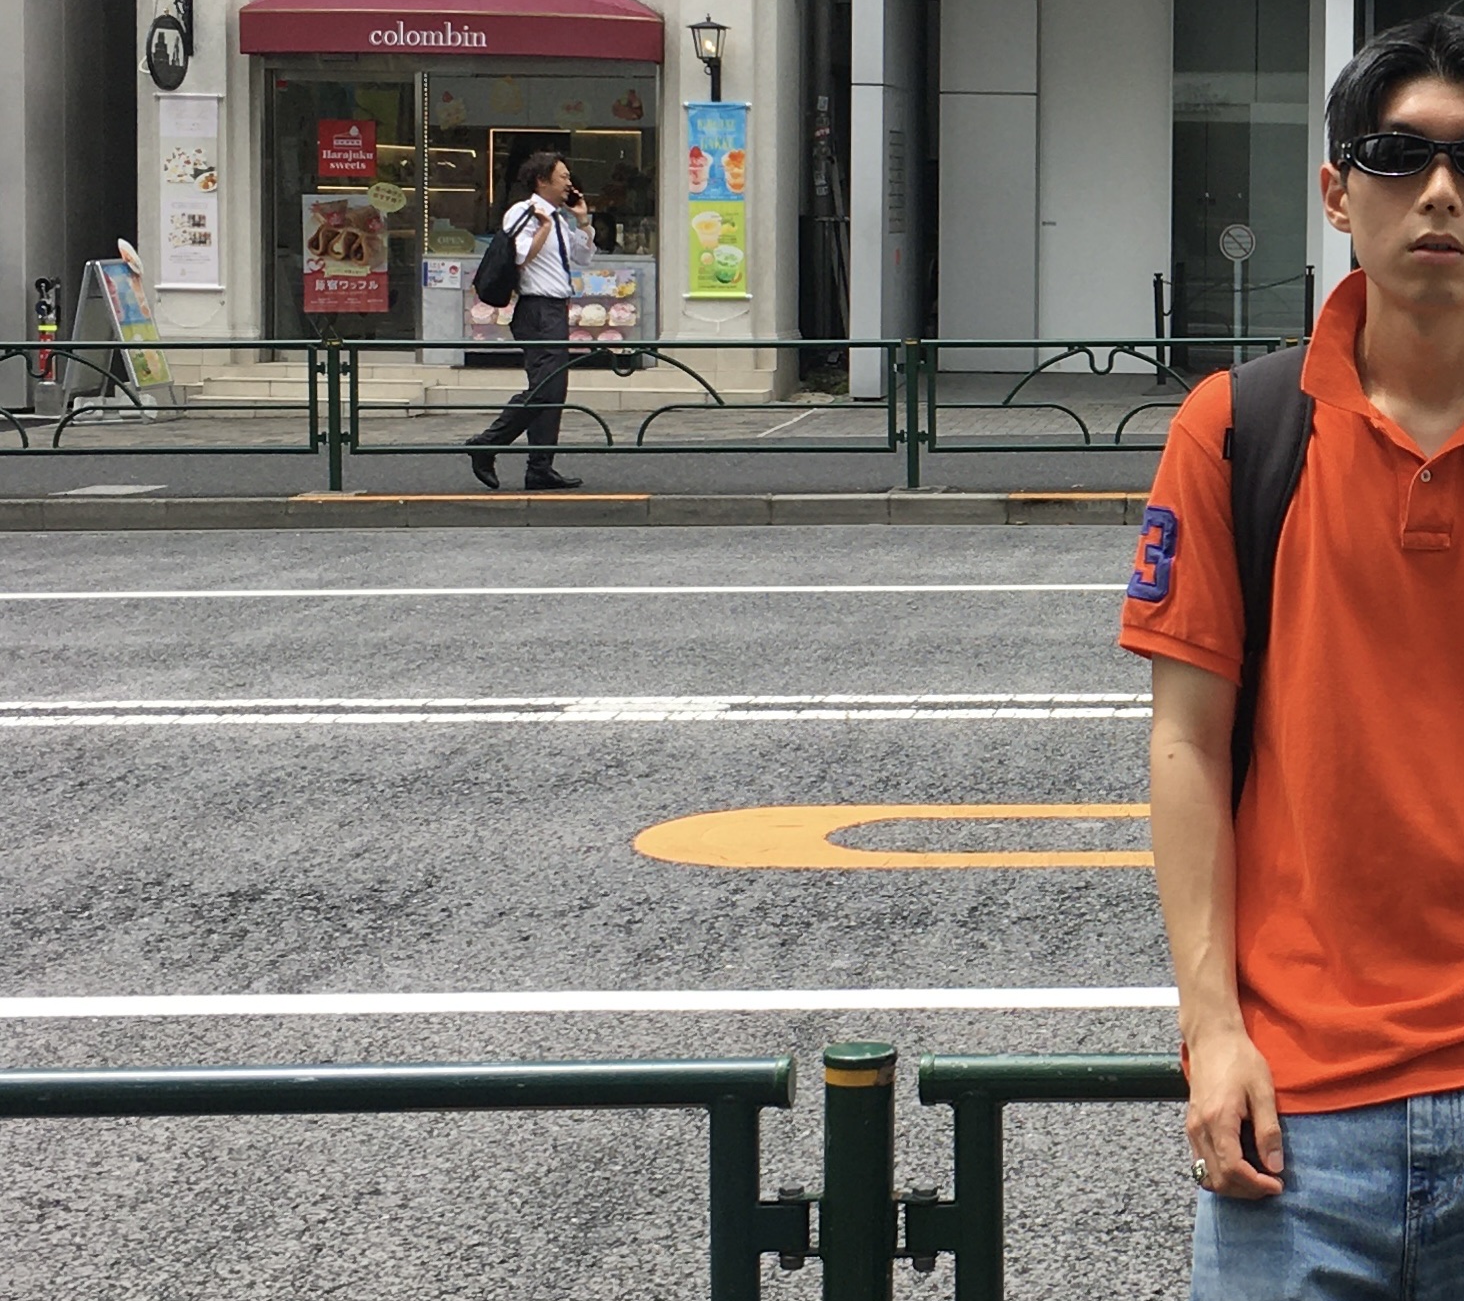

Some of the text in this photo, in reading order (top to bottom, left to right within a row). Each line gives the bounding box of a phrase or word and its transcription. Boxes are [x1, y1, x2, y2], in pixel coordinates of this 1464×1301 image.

[369, 20, 487, 47] colombin
[322, 149, 374, 162] Harajuku
[329, 161, 367, 170] sweets
[1126, 506, 1178, 604] 3
